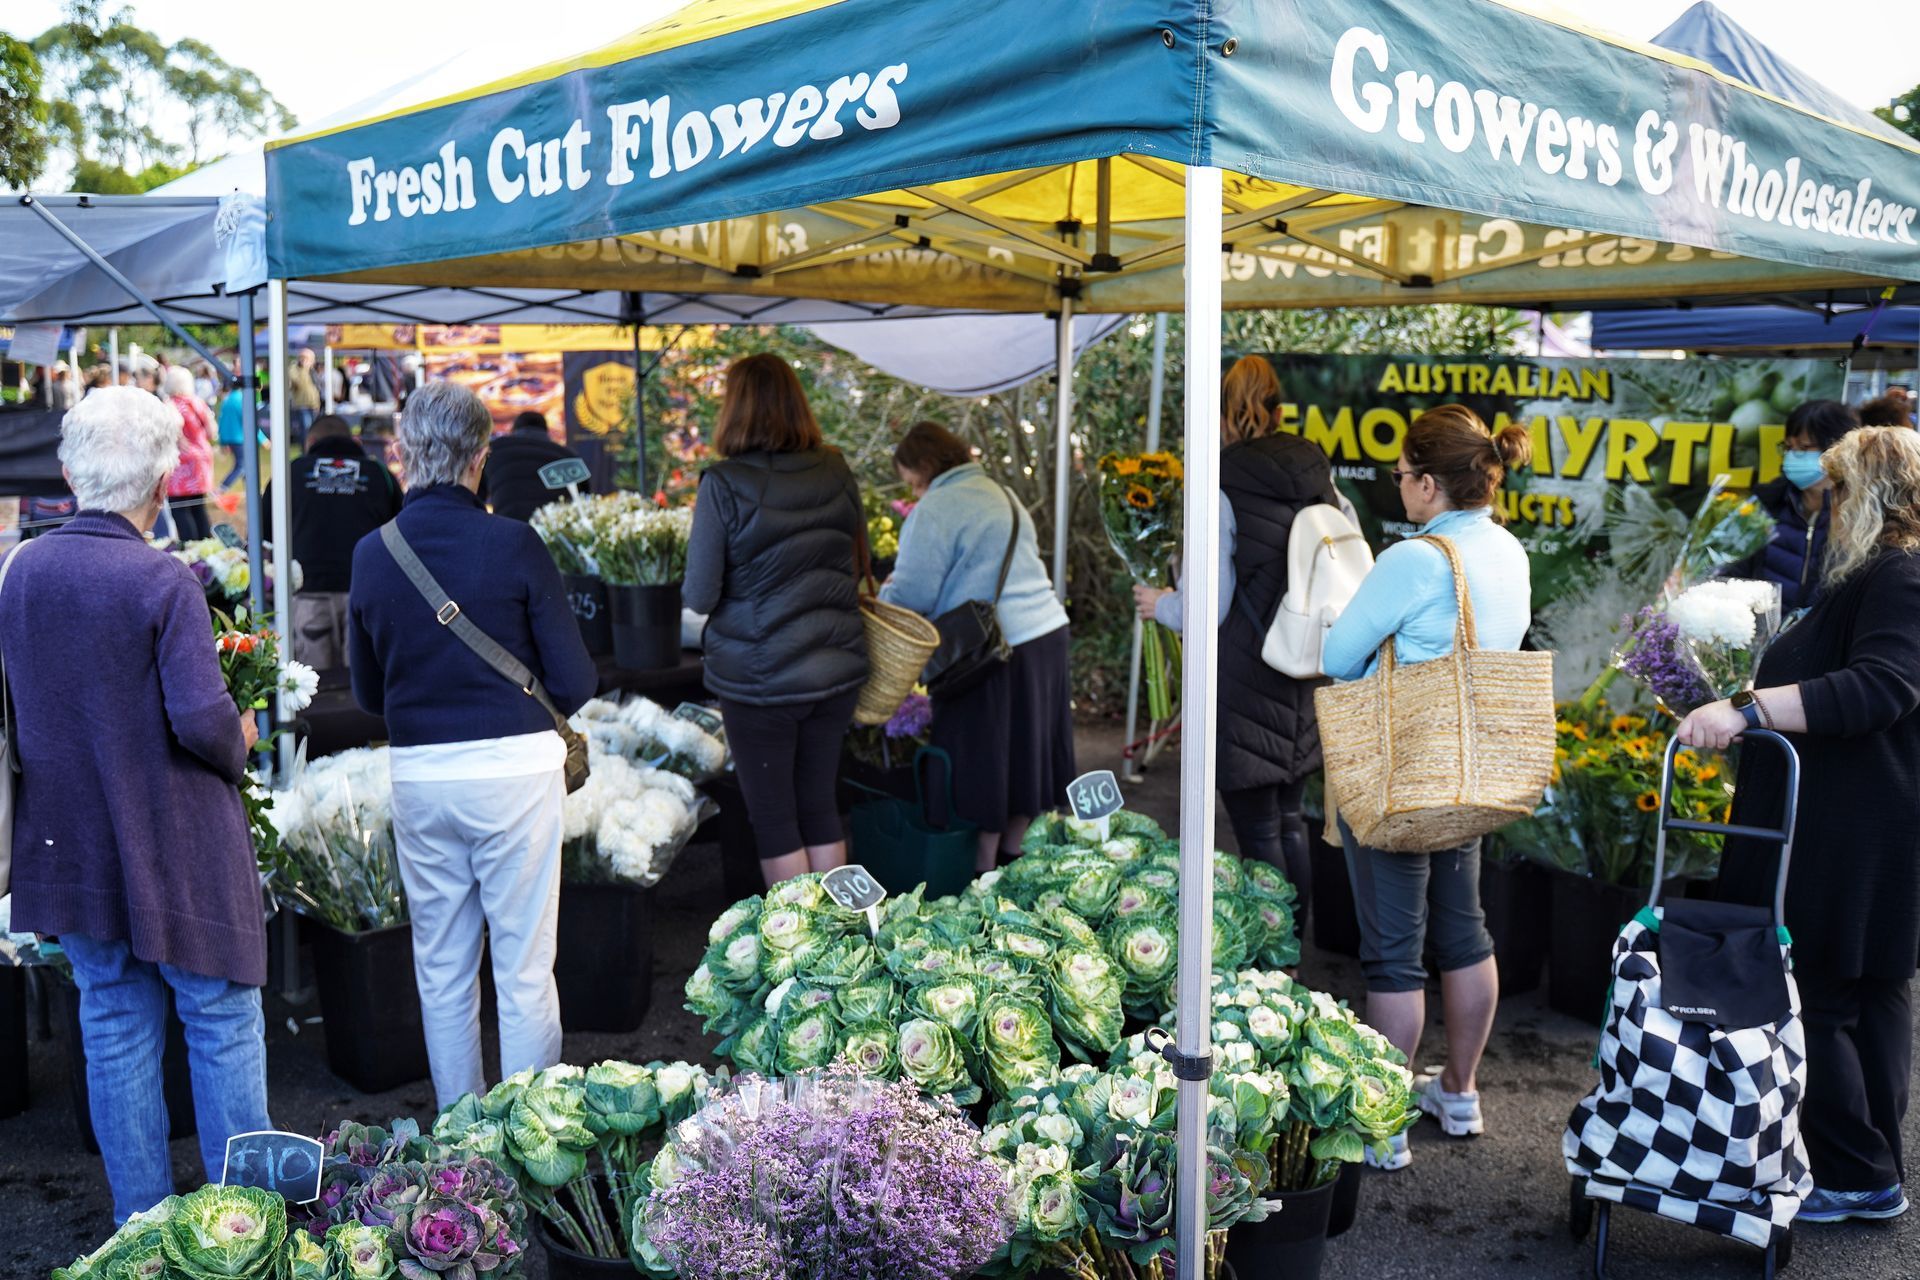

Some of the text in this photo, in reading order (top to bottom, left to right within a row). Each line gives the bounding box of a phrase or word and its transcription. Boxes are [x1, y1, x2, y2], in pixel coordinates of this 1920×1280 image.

[347, 62, 908, 226] Fresh Cut Flowers
[1330, 26, 1918, 246] Growers & Wholesalers
[1379, 363, 1612, 402] AUSTRALIAN
[1338, 465, 1377, 481] MADE
[1076, 779, 1115, 815] $10
[831, 873, 872, 909] $10
[228, 1142, 317, 1190] $10
